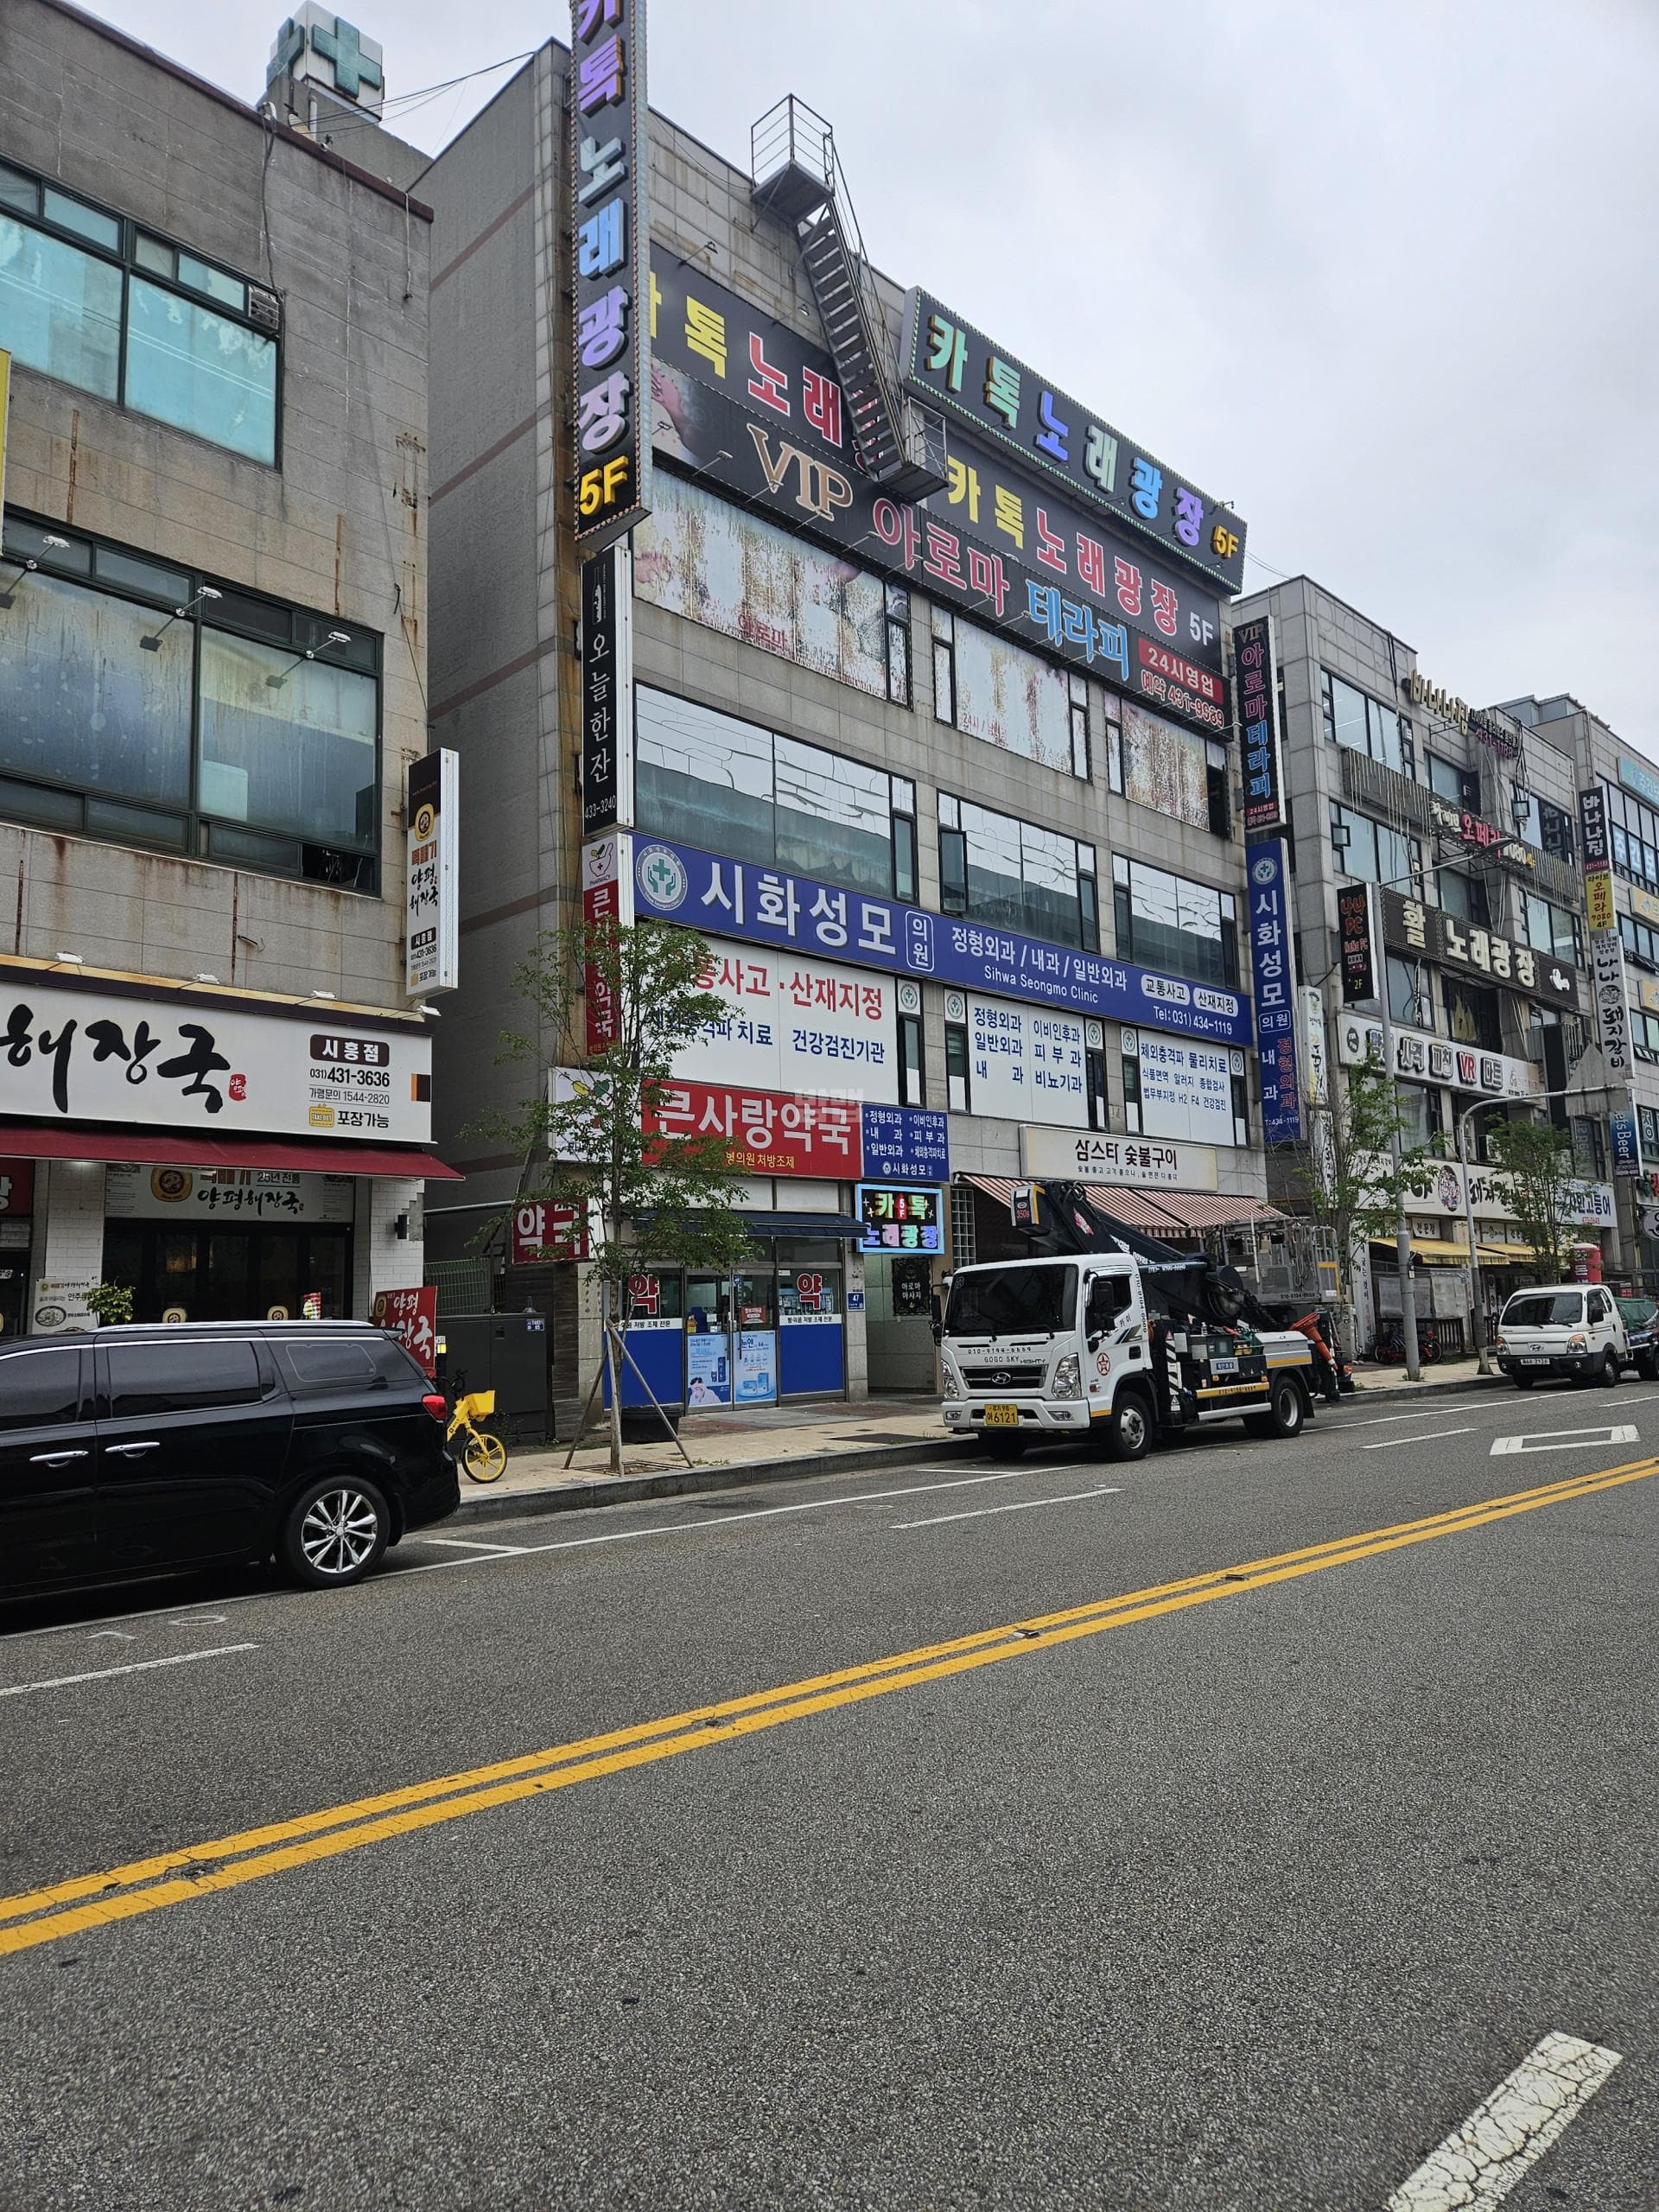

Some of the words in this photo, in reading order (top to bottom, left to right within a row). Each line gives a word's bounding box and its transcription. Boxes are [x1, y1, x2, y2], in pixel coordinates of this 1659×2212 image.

[650, 271, 727, 378] 톡
[580, 457, 628, 515] 5F
[747, 423, 853, 521] VIP
[873, 498, 1009, 618] 아로마
[1025, 578, 1129, 681] 테라피
[1212, 524, 1239, 560] 5F
[1189, 611, 1214, 647] 5F
[1238, 624, 1264, 644] VIP
[1141, 669, 1166, 701] 예약
[1148, 647, 1214, 697] 24시영업
[585, 795, 616, 819] 433-3240
[1583, 795, 1605, 856] 바나나짐
[411, 863, 435, 890] 양평
[590, 874, 610, 886] PHARMACY
[1588, 873, 1609, 882] 라이브
[410, 886, 438, 917] 해장국
[1593, 882, 1607, 912] 오페라
[701, 861, 897, 956] 시화성모
[912, 917, 930, 968] 의원
[1344, 917, 1363, 935] PC
[951, 926, 1016, 965] 정형외과
[1032, 950, 1060, 976] 내과
[1073, 958, 1128, 992] 일반외과
[1255, 890, 1286, 1008] 시화성모
[1446, 918, 1536, 988] 노래광장
[678, 952, 771, 996] 통사고
[1354, 979, 1363, 990] 2F
[1597, 957, 1620, 982] 나나
[984, 966, 1017, 987] Sihwa
[1020, 973, 1067, 998] Seongmo
[1071, 986, 1099, 1004] Clinic
[1146, 978, 1186, 1001] 교통사고
[1198, 992, 1236, 1014] 산재지정
[974, 1007, 1022, 1033] 정형외과
[1033, 1020, 1081, 1045] 이비인후과
[1193, 1017, 1232, 1035] 434-1119
[1262, 1012, 1289, 1029] 의원
[322, 1039, 378, 1063] 시흥점
[737, 1020, 773, 1046] 치료
[792, 1028, 885, 1064] 건강검진기관
[975, 1033, 1023, 1058] 일반외과
[1602, 1006, 1627, 1068] 돼지갈비
[1141, 1043, 1184, 1066] 체외충격파
[1189, 1052, 1227, 1073] 물리치료
[1399, 1038, 1425, 1071] 사격
[1458, 1052, 1478, 1084] VR
[1035, 1071, 1083, 1094] 비뇨기과
[1142, 1067, 1168, 1083] 식품면역
[1173, 1073, 1194, 1087] 알러지
[1199, 1077, 1224, 1092] 종합검사
[1277, 1038, 1297, 1109] 정형외과
[309, 1088, 340, 1100] 가맹문의
[343, 1091, 390, 1104] 1544-2820
[1143, 1088, 1175, 1103] 법무부지정
[1179, 1093, 1187, 1104] H2
[1191, 1095, 1199, 1105] F4
[1203, 1097, 1226, 1110] 건강검진
[337, 1111, 389, 1128] 포장가능
[654, 1089, 851, 1155] 큰사랑약국
[869, 1110, 902, 1126] 정형외과
[912, 1114, 944, 1128] 이비인후과
[870, 1143, 903, 1157] 일반외과
[1075, 1140, 1119, 1165] 삼스타
[1124, 1145, 1178, 1170] 숯불구이
[1617, 1130, 1632, 1159] Beer
[757, 1154, 795, 1169] 처방조제
[893, 1163, 926, 1176] 시화성모
[198, 1187, 300, 1217] 양평해장국
[517, 1203, 581, 1257] 약국
[393, 1291, 419, 1316] 양평
[628, 1274, 660, 1314] 약
[797, 1273, 822, 1310] 약
[902, 1291, 921, 1300] 마사지
[381, 1315, 433, 1359] 장국
